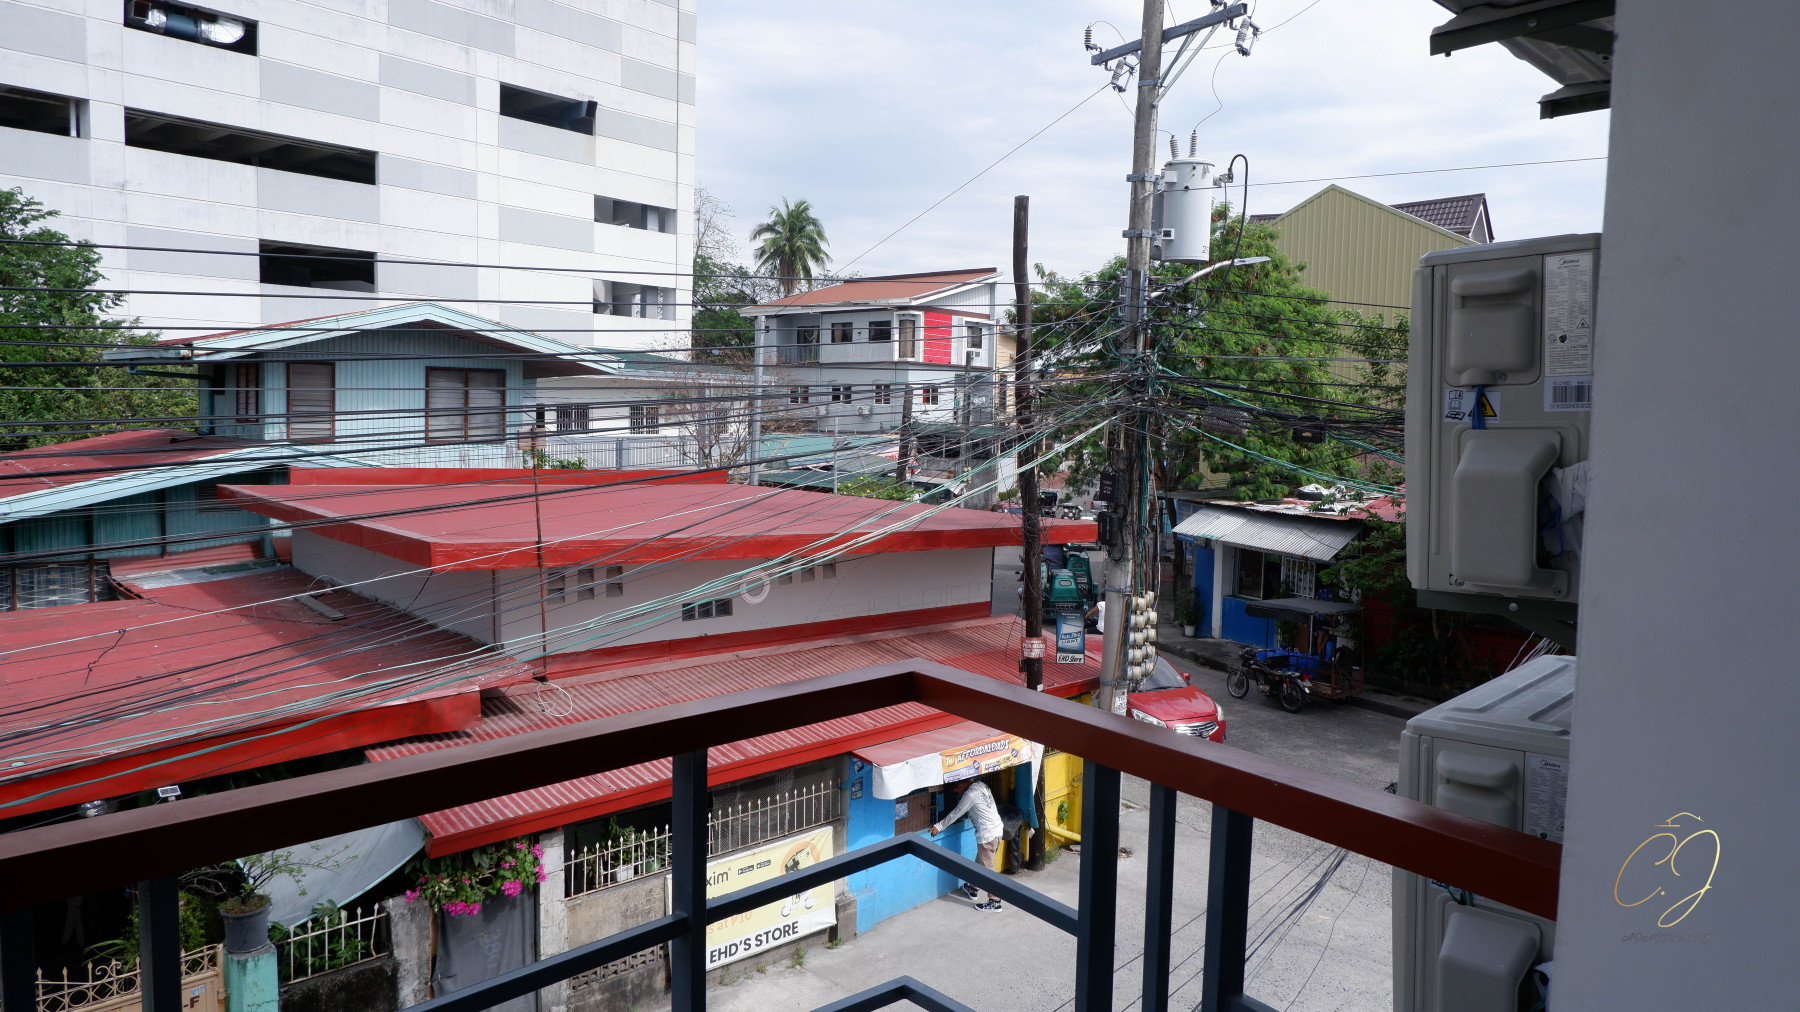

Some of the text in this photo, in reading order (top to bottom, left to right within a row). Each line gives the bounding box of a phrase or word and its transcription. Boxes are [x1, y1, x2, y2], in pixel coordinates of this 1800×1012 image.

[957, 739, 1010, 763] AFFORDALOADS
[706, 871, 729, 887] xim
[755, 921, 799, 947] STORE
